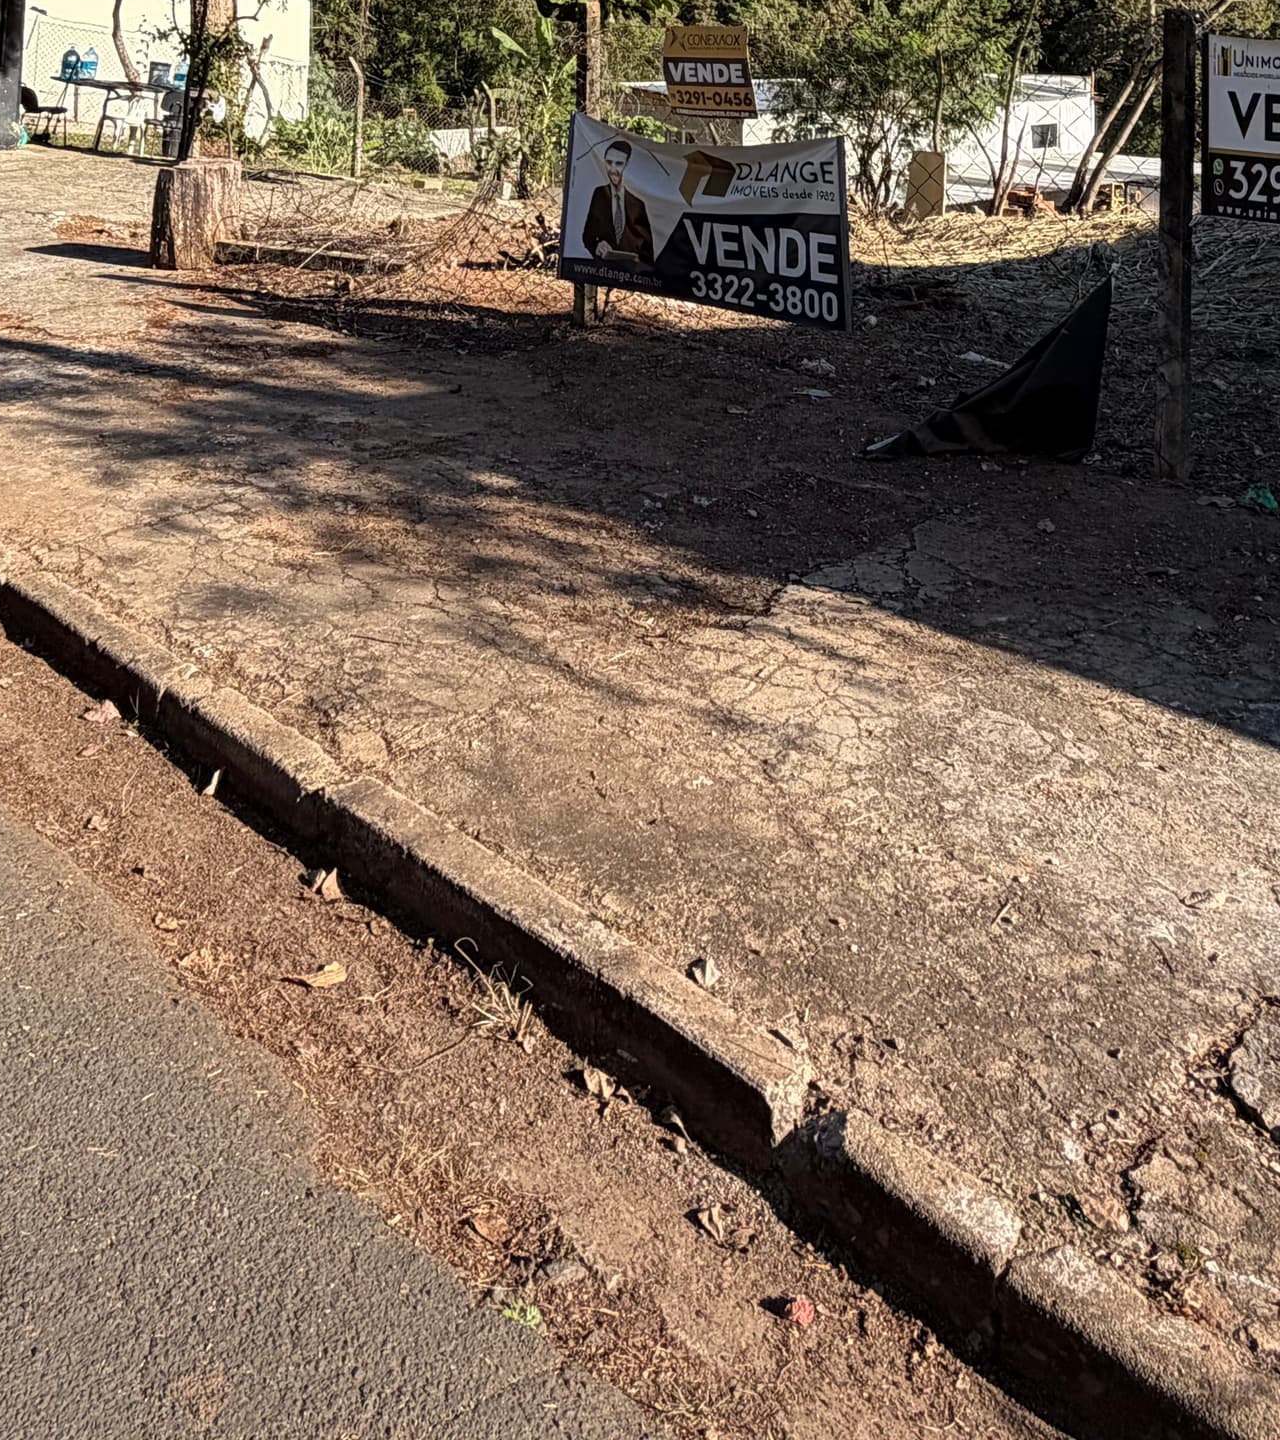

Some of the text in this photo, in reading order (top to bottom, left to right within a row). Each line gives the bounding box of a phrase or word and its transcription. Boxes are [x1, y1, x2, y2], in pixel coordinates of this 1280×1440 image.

[667, 62, 745, 84] VENDE
[676, 90, 753, 107] 3291-0456
[735, 161, 834, 185] D.LANGE
[730, 183, 835, 202] IMÓVEIS desde 1982
[683, 218, 838, 285] VENDE
[573, 262, 663, 288] www.dlange.com.br
[689, 271, 838, 322] 3322-3800
